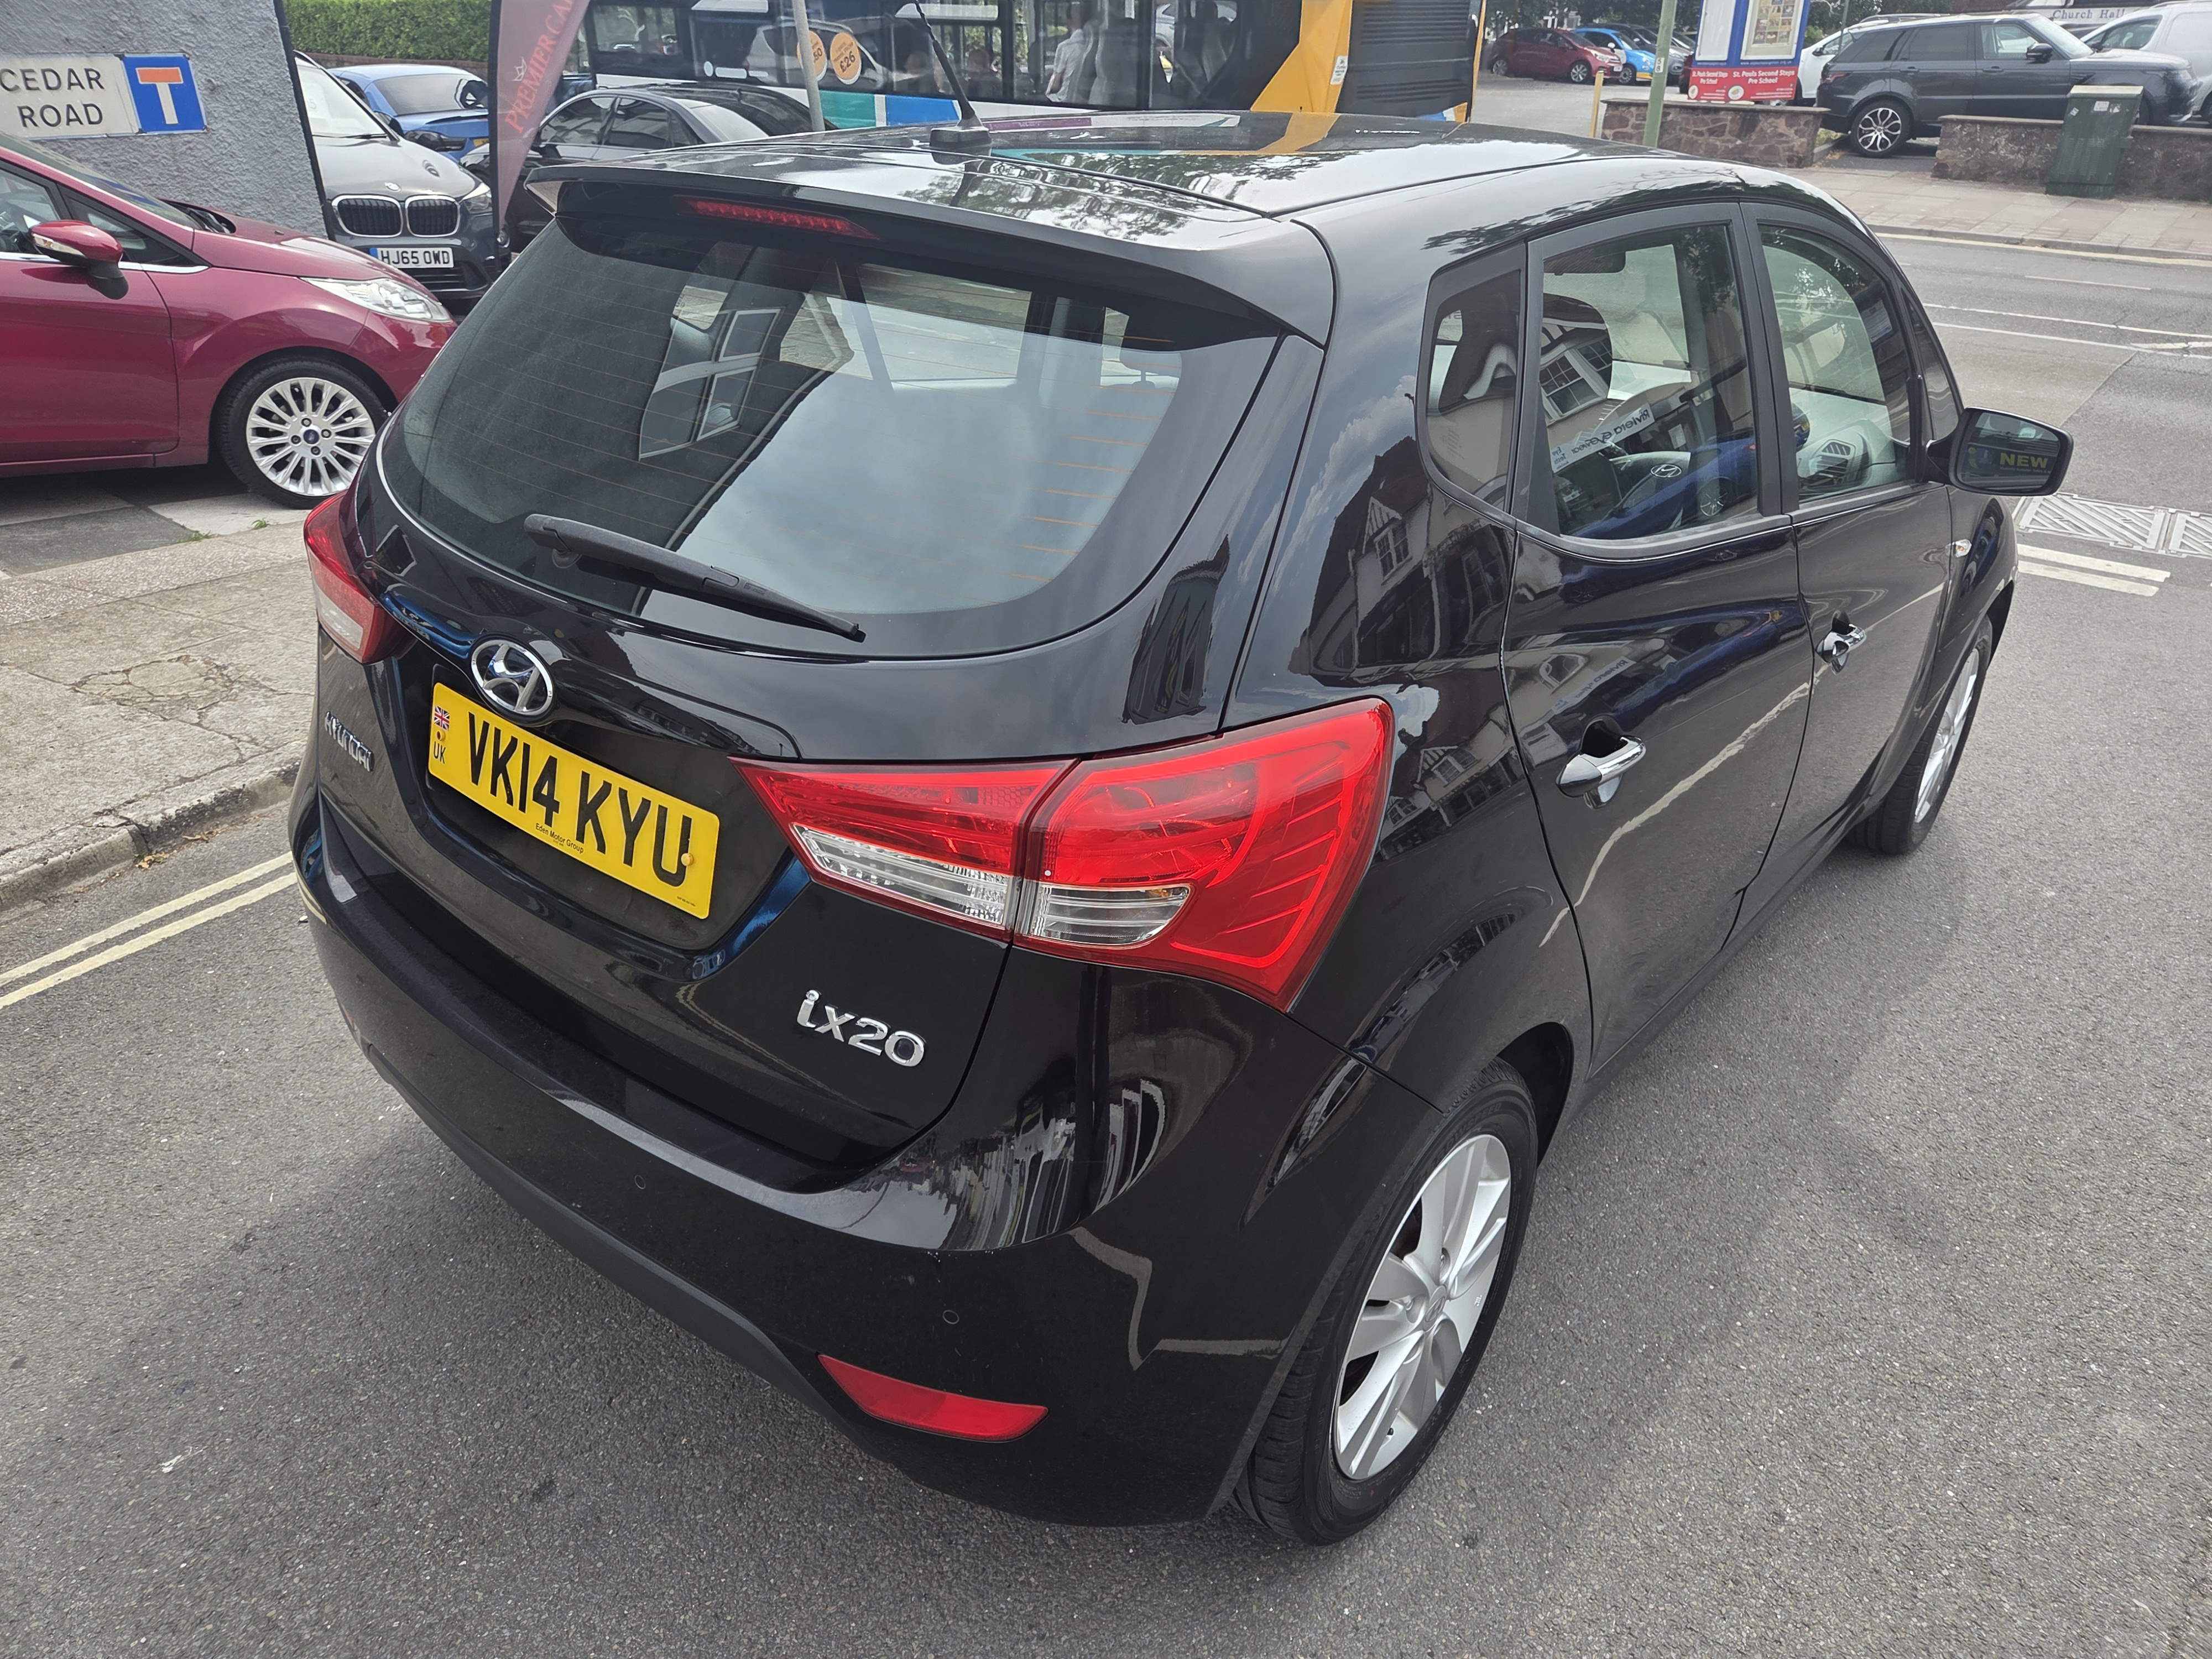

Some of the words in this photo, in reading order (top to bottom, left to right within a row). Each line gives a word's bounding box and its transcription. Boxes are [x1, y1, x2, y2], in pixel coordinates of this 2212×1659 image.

[2052, 9, 2093, 20] Church
[2099, 8, 2125, 19] Hall
[839, 50, 856, 73] £26
[0, 67, 105, 92] CEDAR
[504, 34, 557, 134] PREMIER
[17, 103, 103, 128] ROAD
[380, 250, 420, 265] HJ65
[424, 251, 450, 265] OWD
[2000, 452, 2048, 469] NEW
[433, 740, 446, 765] UK
[468, 711, 560, 828] VK14
[575, 770, 692, 887] KYU
[535, 822, 549, 836] Eden
[550, 830, 566, 844] Motor
[566, 838, 584, 854] Group
[796, 989, 925, 1067] ix20
